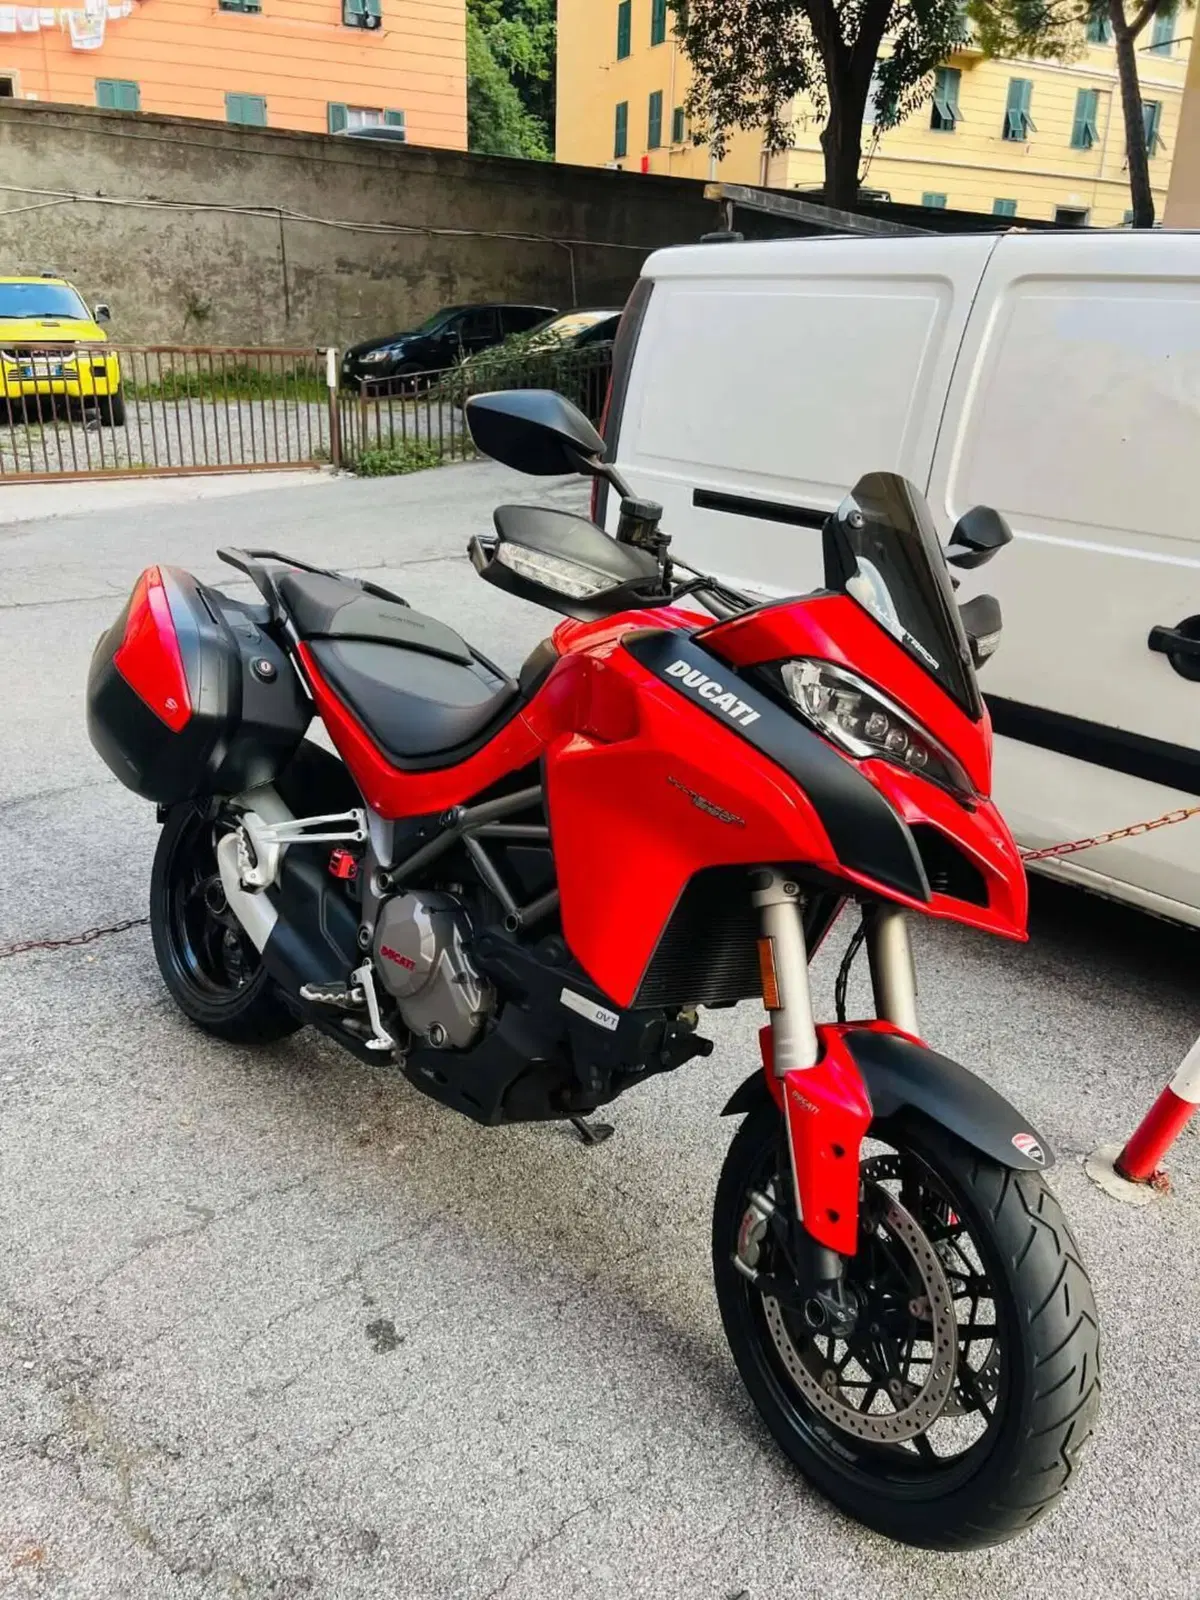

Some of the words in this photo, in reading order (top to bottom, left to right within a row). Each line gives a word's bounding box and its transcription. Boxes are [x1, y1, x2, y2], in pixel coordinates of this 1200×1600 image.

[664, 659, 762, 727] DUCATI
[380, 944, 417, 972] DUCATI
[595, 1010, 618, 1026] DVT
